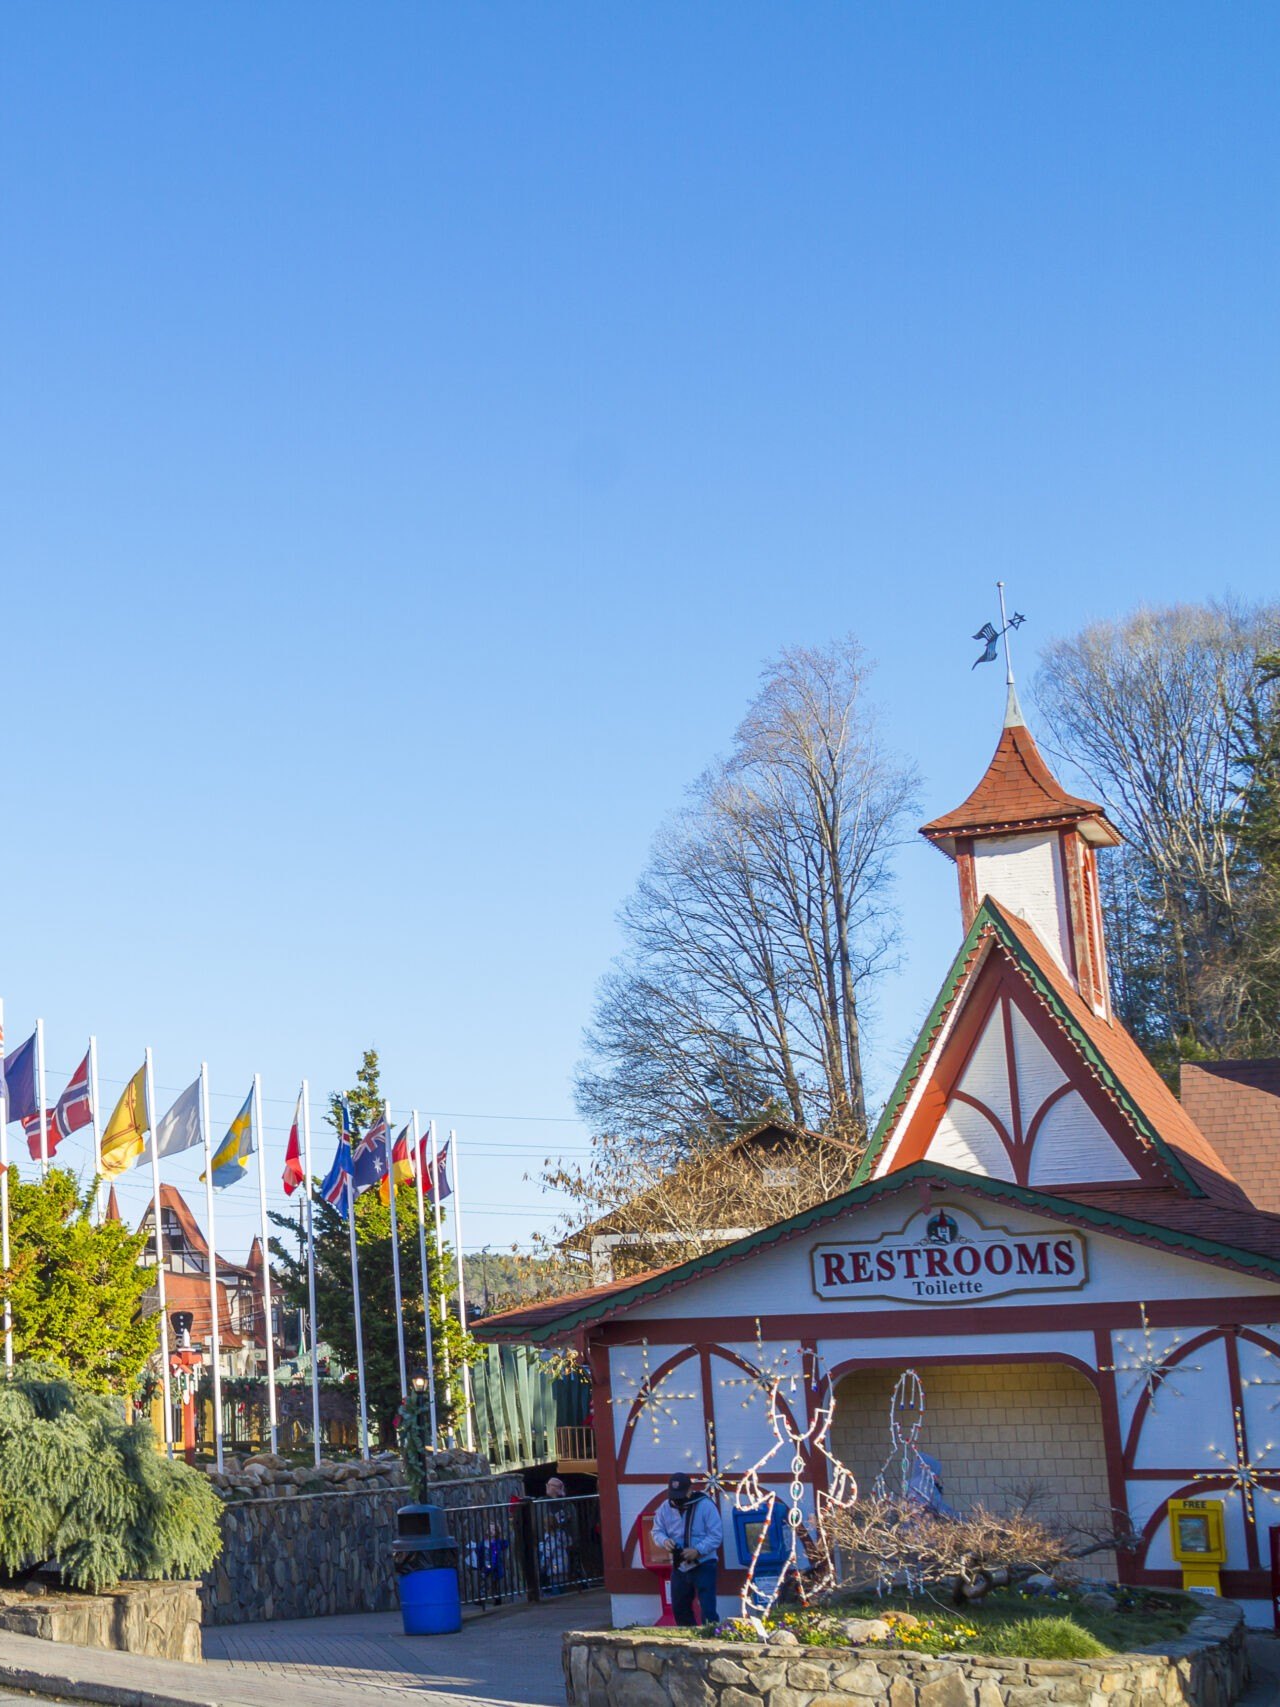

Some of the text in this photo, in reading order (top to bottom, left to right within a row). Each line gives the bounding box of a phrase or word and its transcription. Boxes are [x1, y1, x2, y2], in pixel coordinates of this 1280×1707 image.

[820, 1240, 1076, 1287] RESTROOMS
[912, 1280, 983, 1296] Toilette
[1182, 1500, 1207, 1509] FREE
